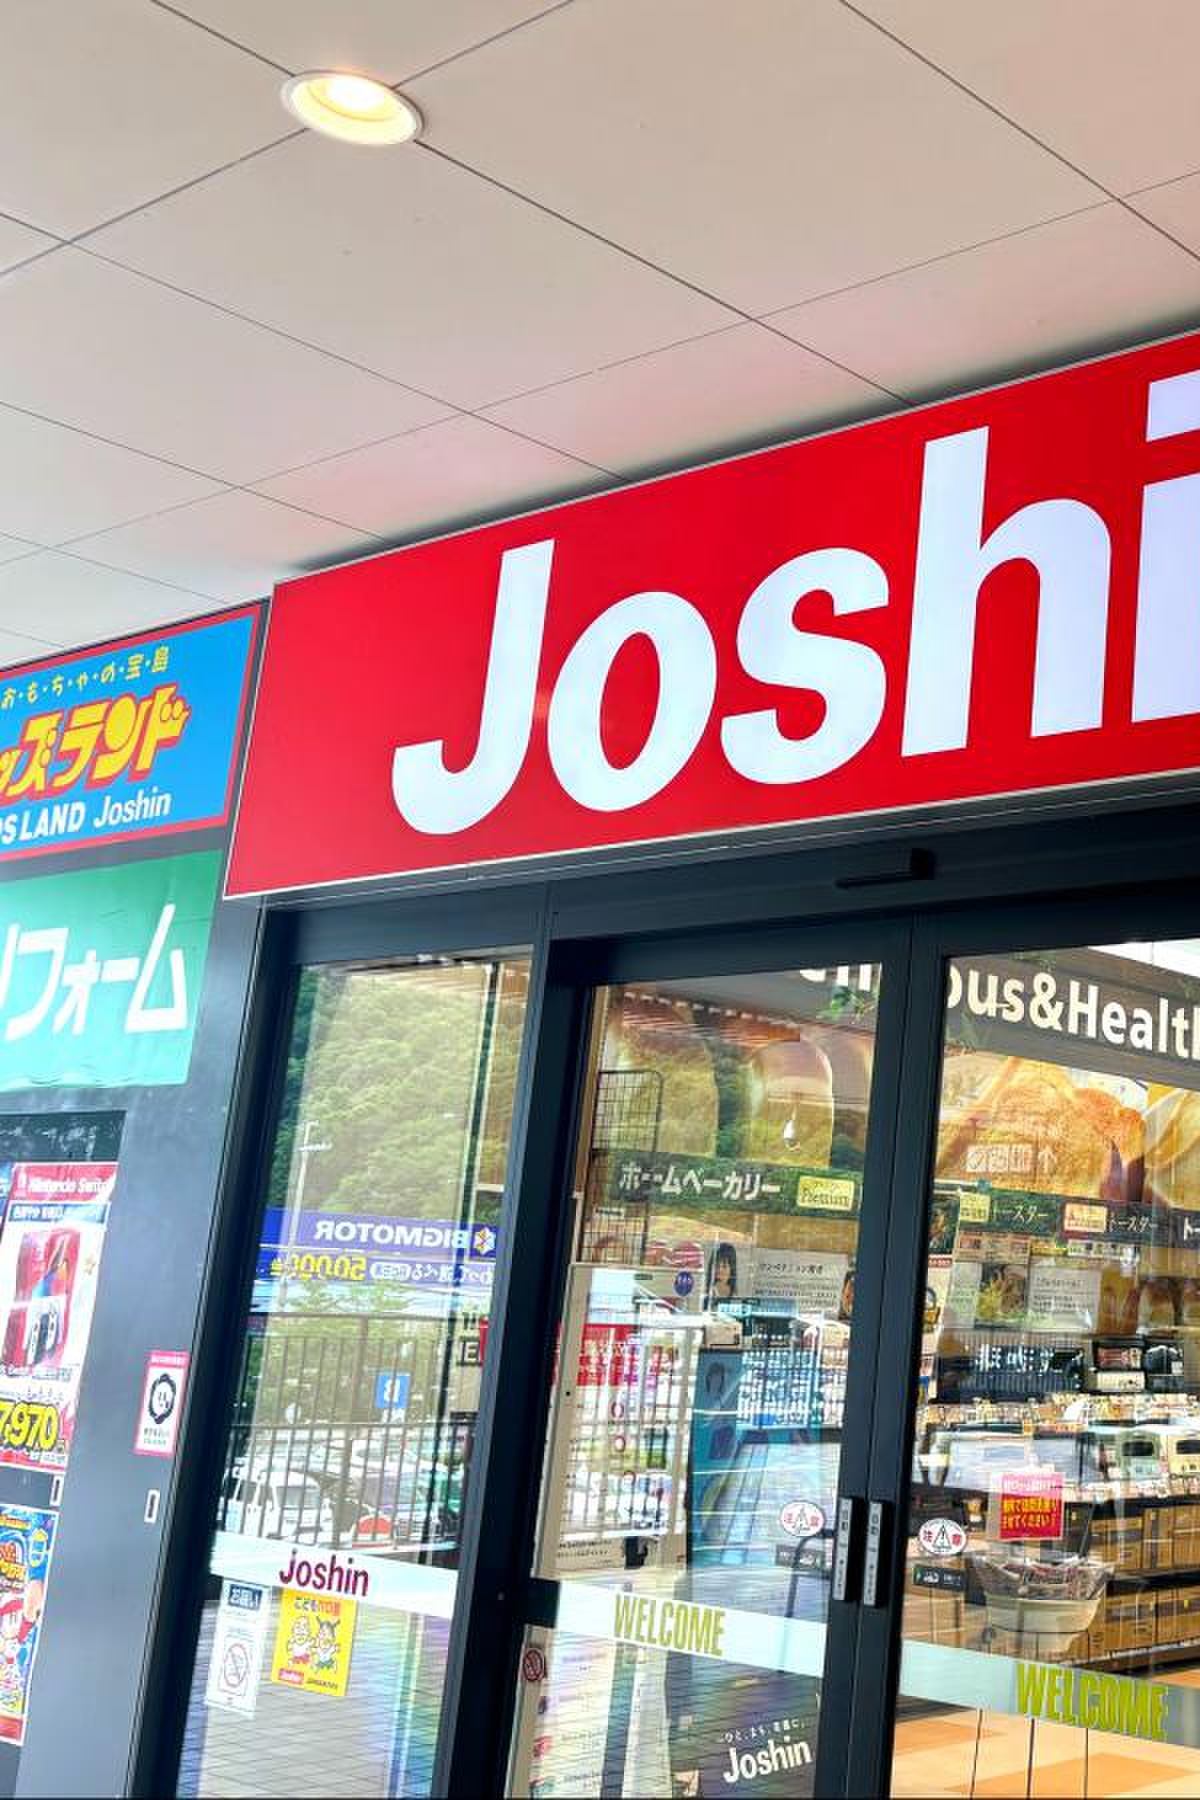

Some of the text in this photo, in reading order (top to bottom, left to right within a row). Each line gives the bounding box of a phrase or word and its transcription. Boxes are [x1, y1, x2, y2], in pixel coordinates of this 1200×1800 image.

[0, 786, 172, 844] S LAND Joshin
[279, 1547, 370, 1597] Joshin
[613, 1592, 726, 1656] WELCOME
[1016, 1662, 1169, 1741] WELCOME
[722, 1734, 813, 1784] Joshin
